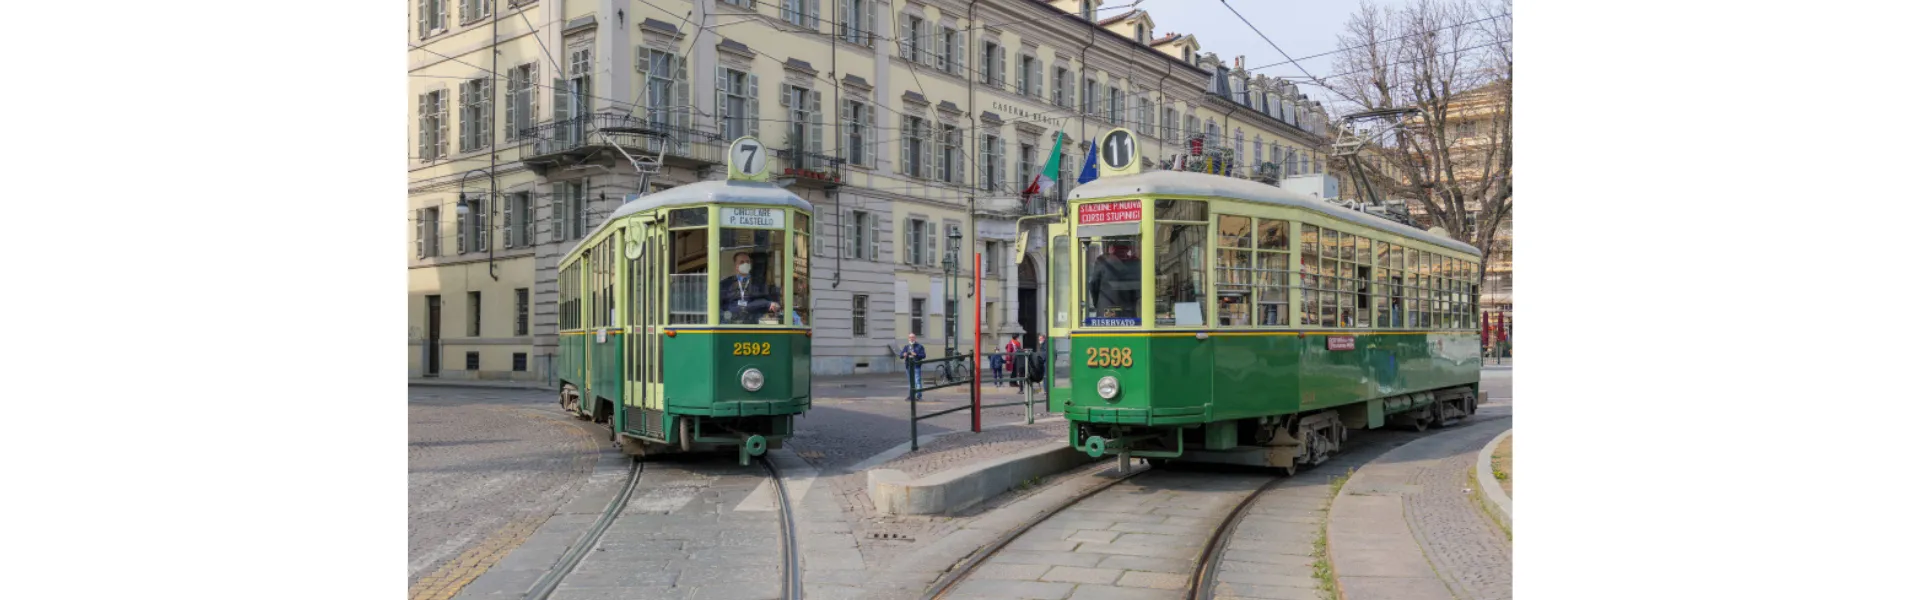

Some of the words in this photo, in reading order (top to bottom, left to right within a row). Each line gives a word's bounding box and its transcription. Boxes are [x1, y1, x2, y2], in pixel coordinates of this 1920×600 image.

[992, 101, 1029, 117] CASERMA
[1109, 134, 1135, 166] 11
[740, 144, 758, 174] 7
[739, 216, 774, 226] CASTELLO
[1082, 214, 1104, 223] CORSO
[733, 342, 771, 356] 2592
[1086, 347, 1133, 368] 2598
